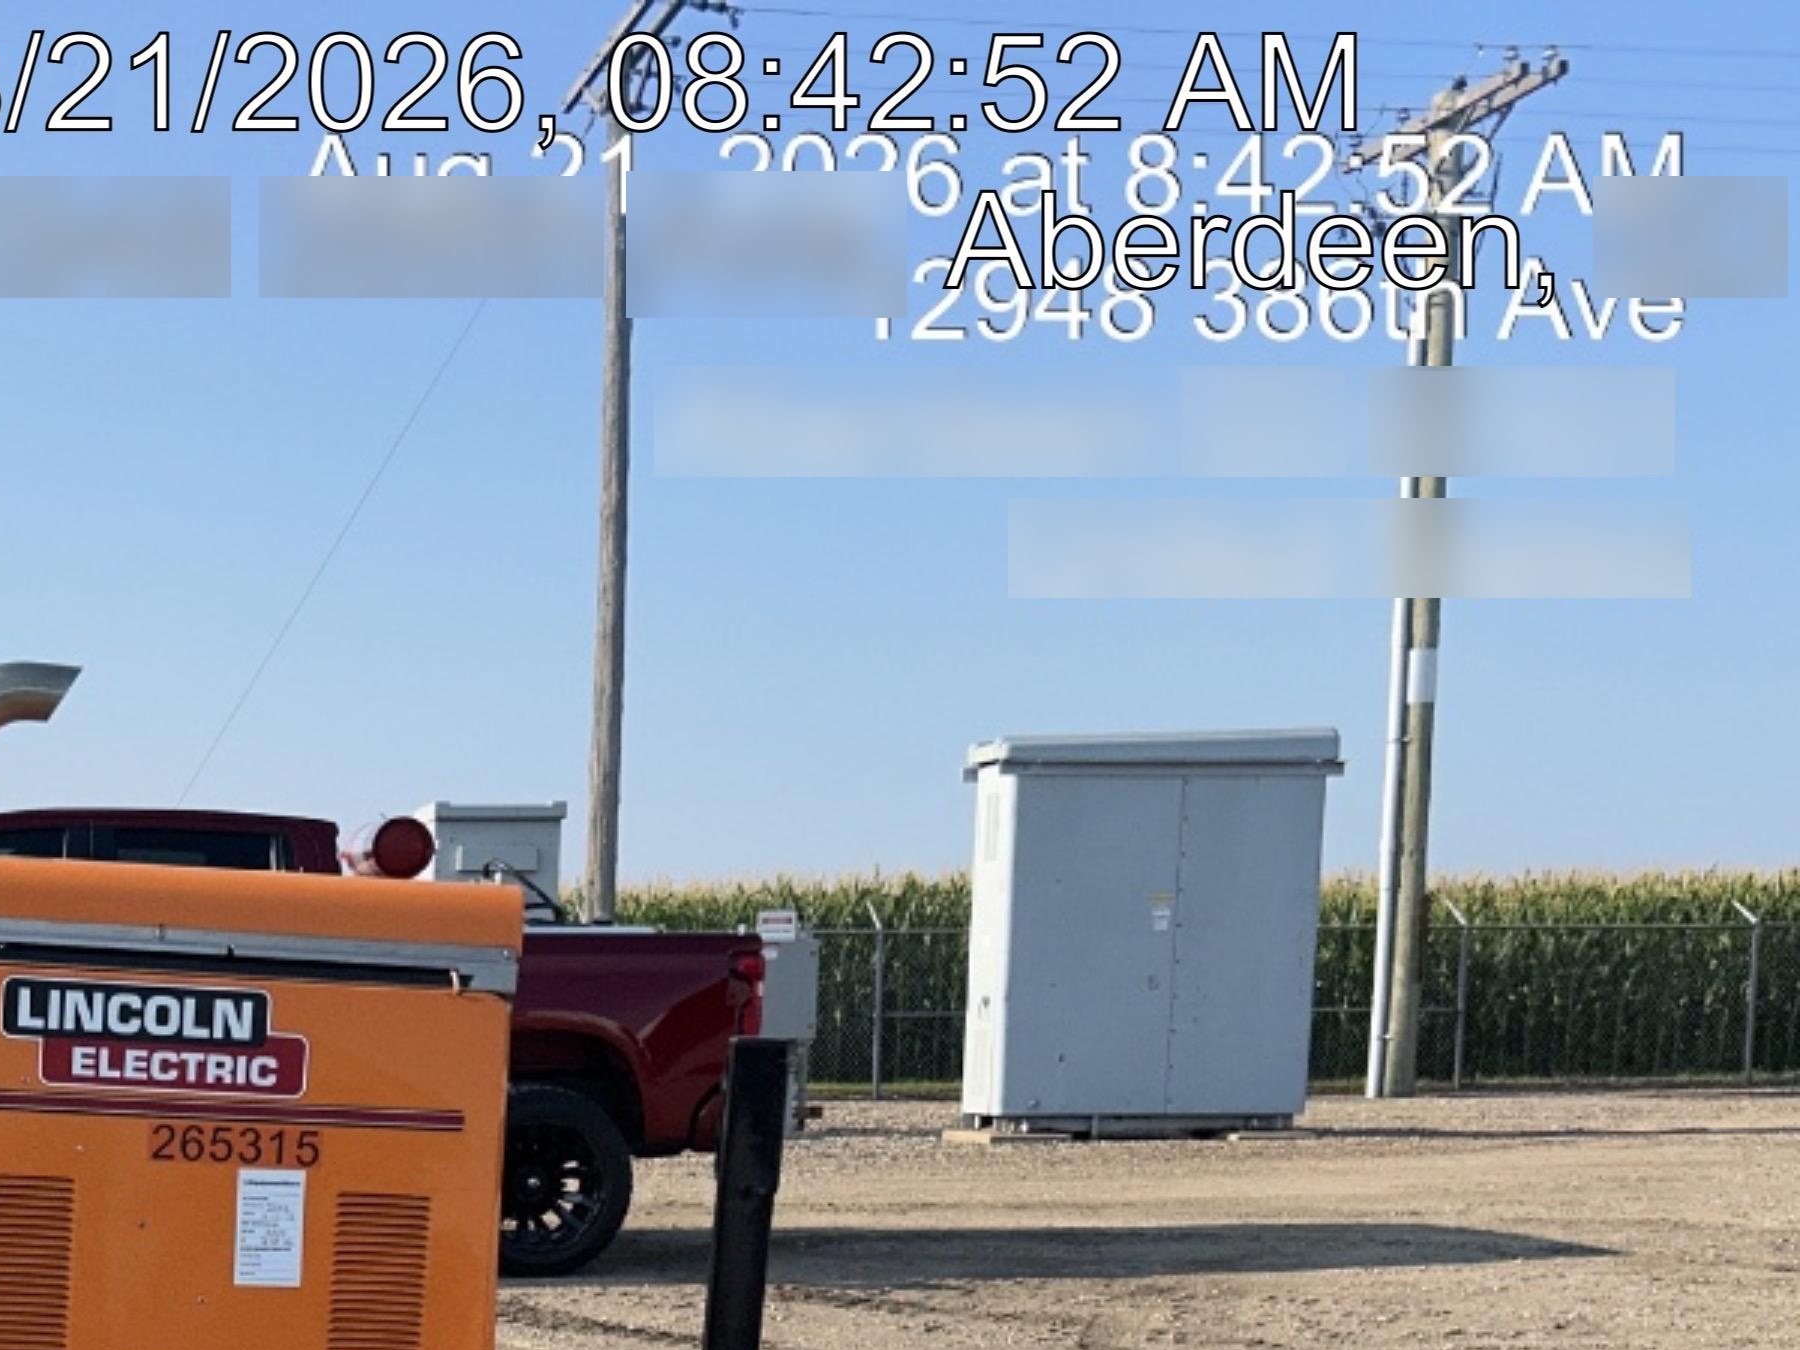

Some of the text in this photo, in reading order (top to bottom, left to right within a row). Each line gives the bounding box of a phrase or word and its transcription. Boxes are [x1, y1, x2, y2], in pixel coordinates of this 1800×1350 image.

[16, 986, 253, 1042] LINCOLN
[70, 1046, 278, 1088] ELECTRIC
[151, 1123, 320, 1168] 265315
